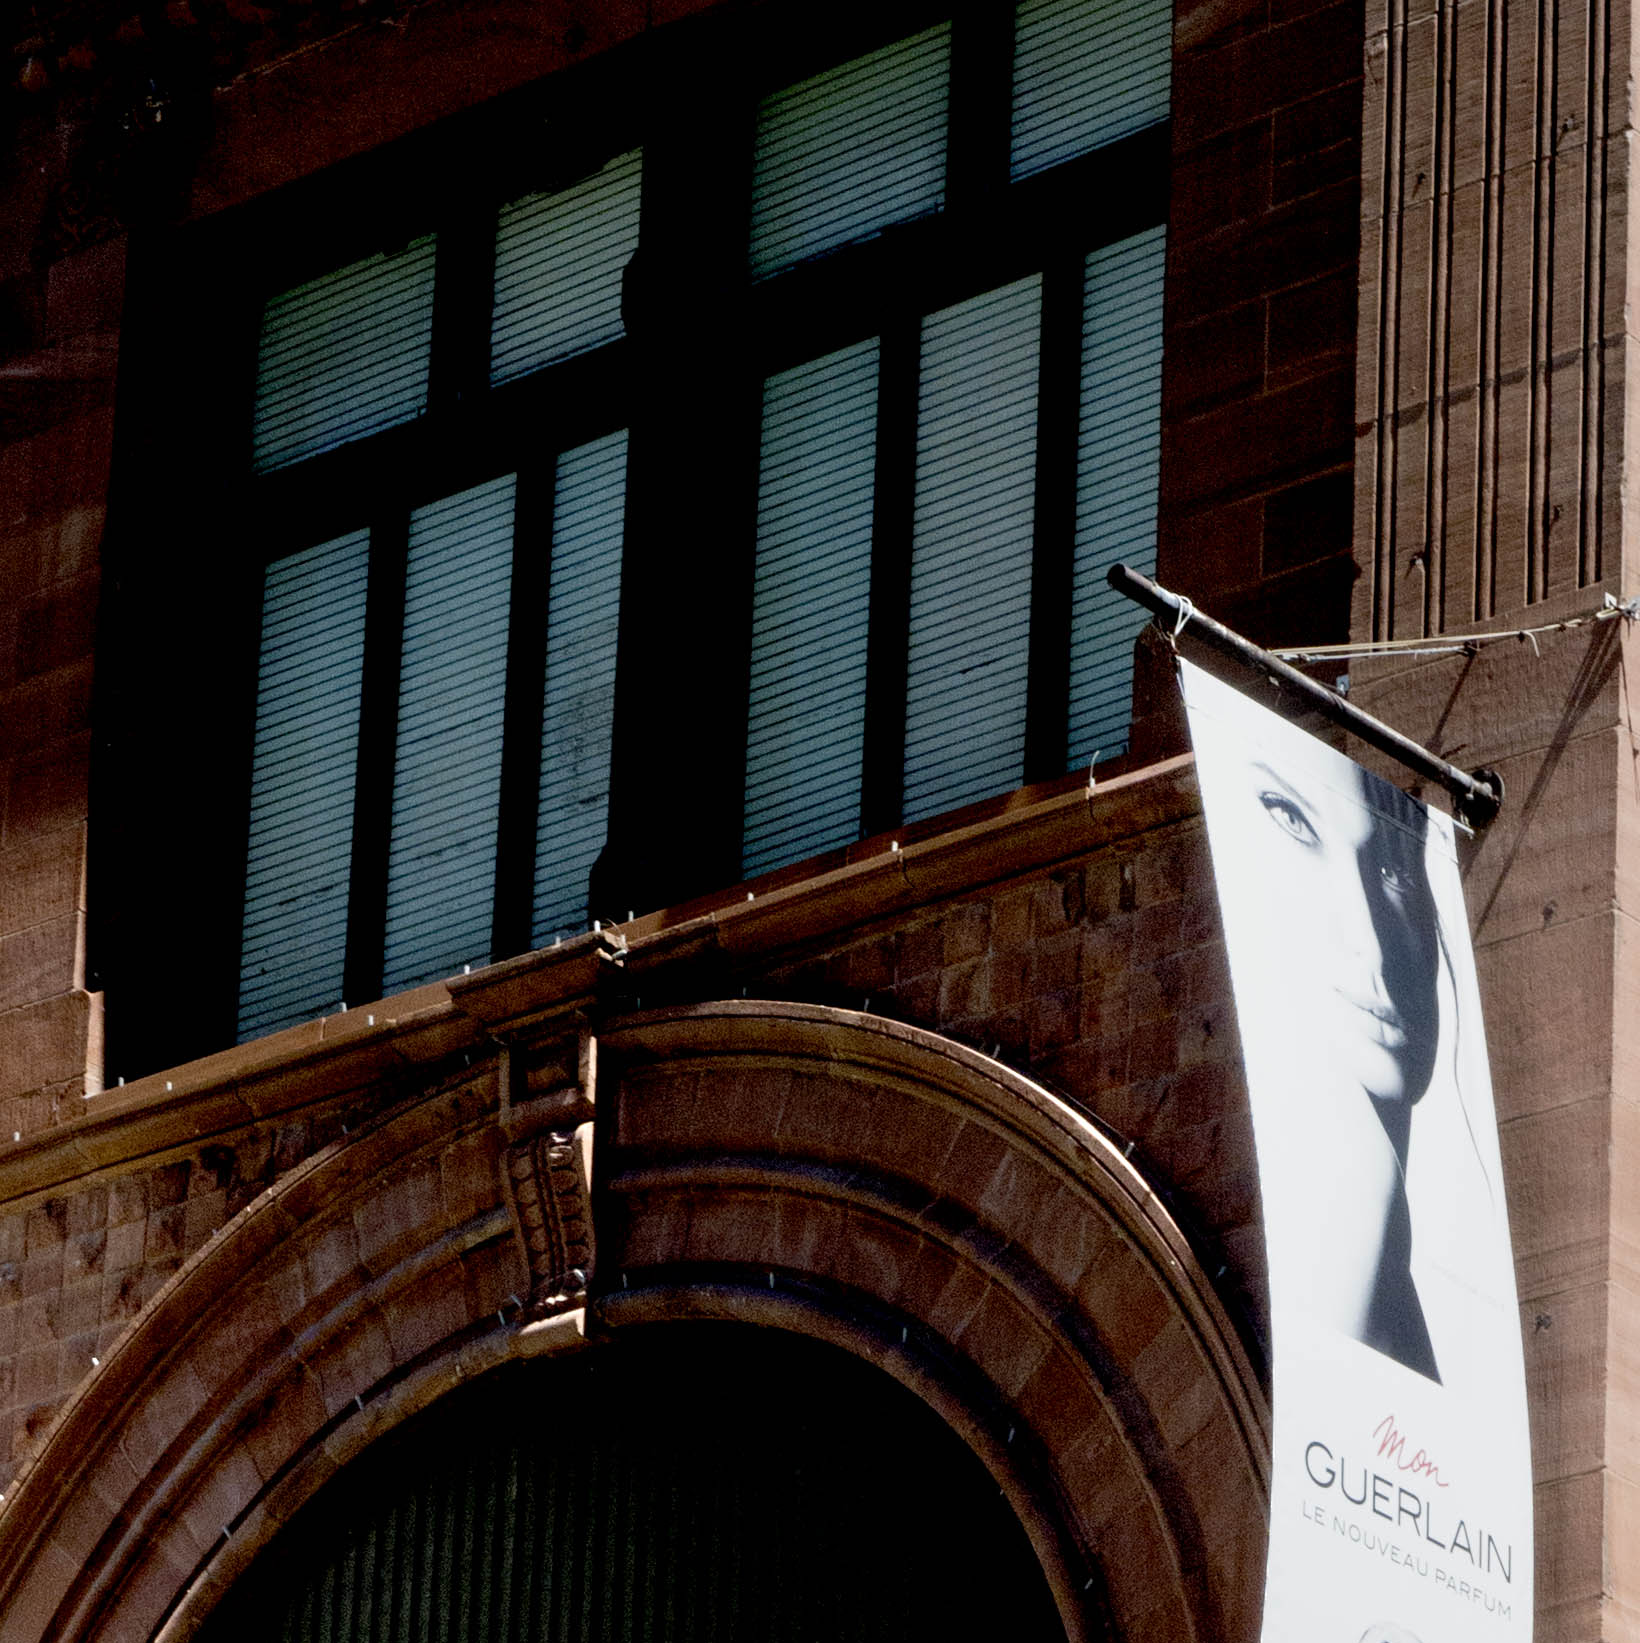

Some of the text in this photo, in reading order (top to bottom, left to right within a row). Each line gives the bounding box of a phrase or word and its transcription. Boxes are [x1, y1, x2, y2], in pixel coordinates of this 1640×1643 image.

[1373, 1415, 1449, 1487] Mon
[1302, 1500, 1512, 1620] LE NOUVEAU PARFUM
[1305, 1441, 1512, 1584] GUERLAIN
